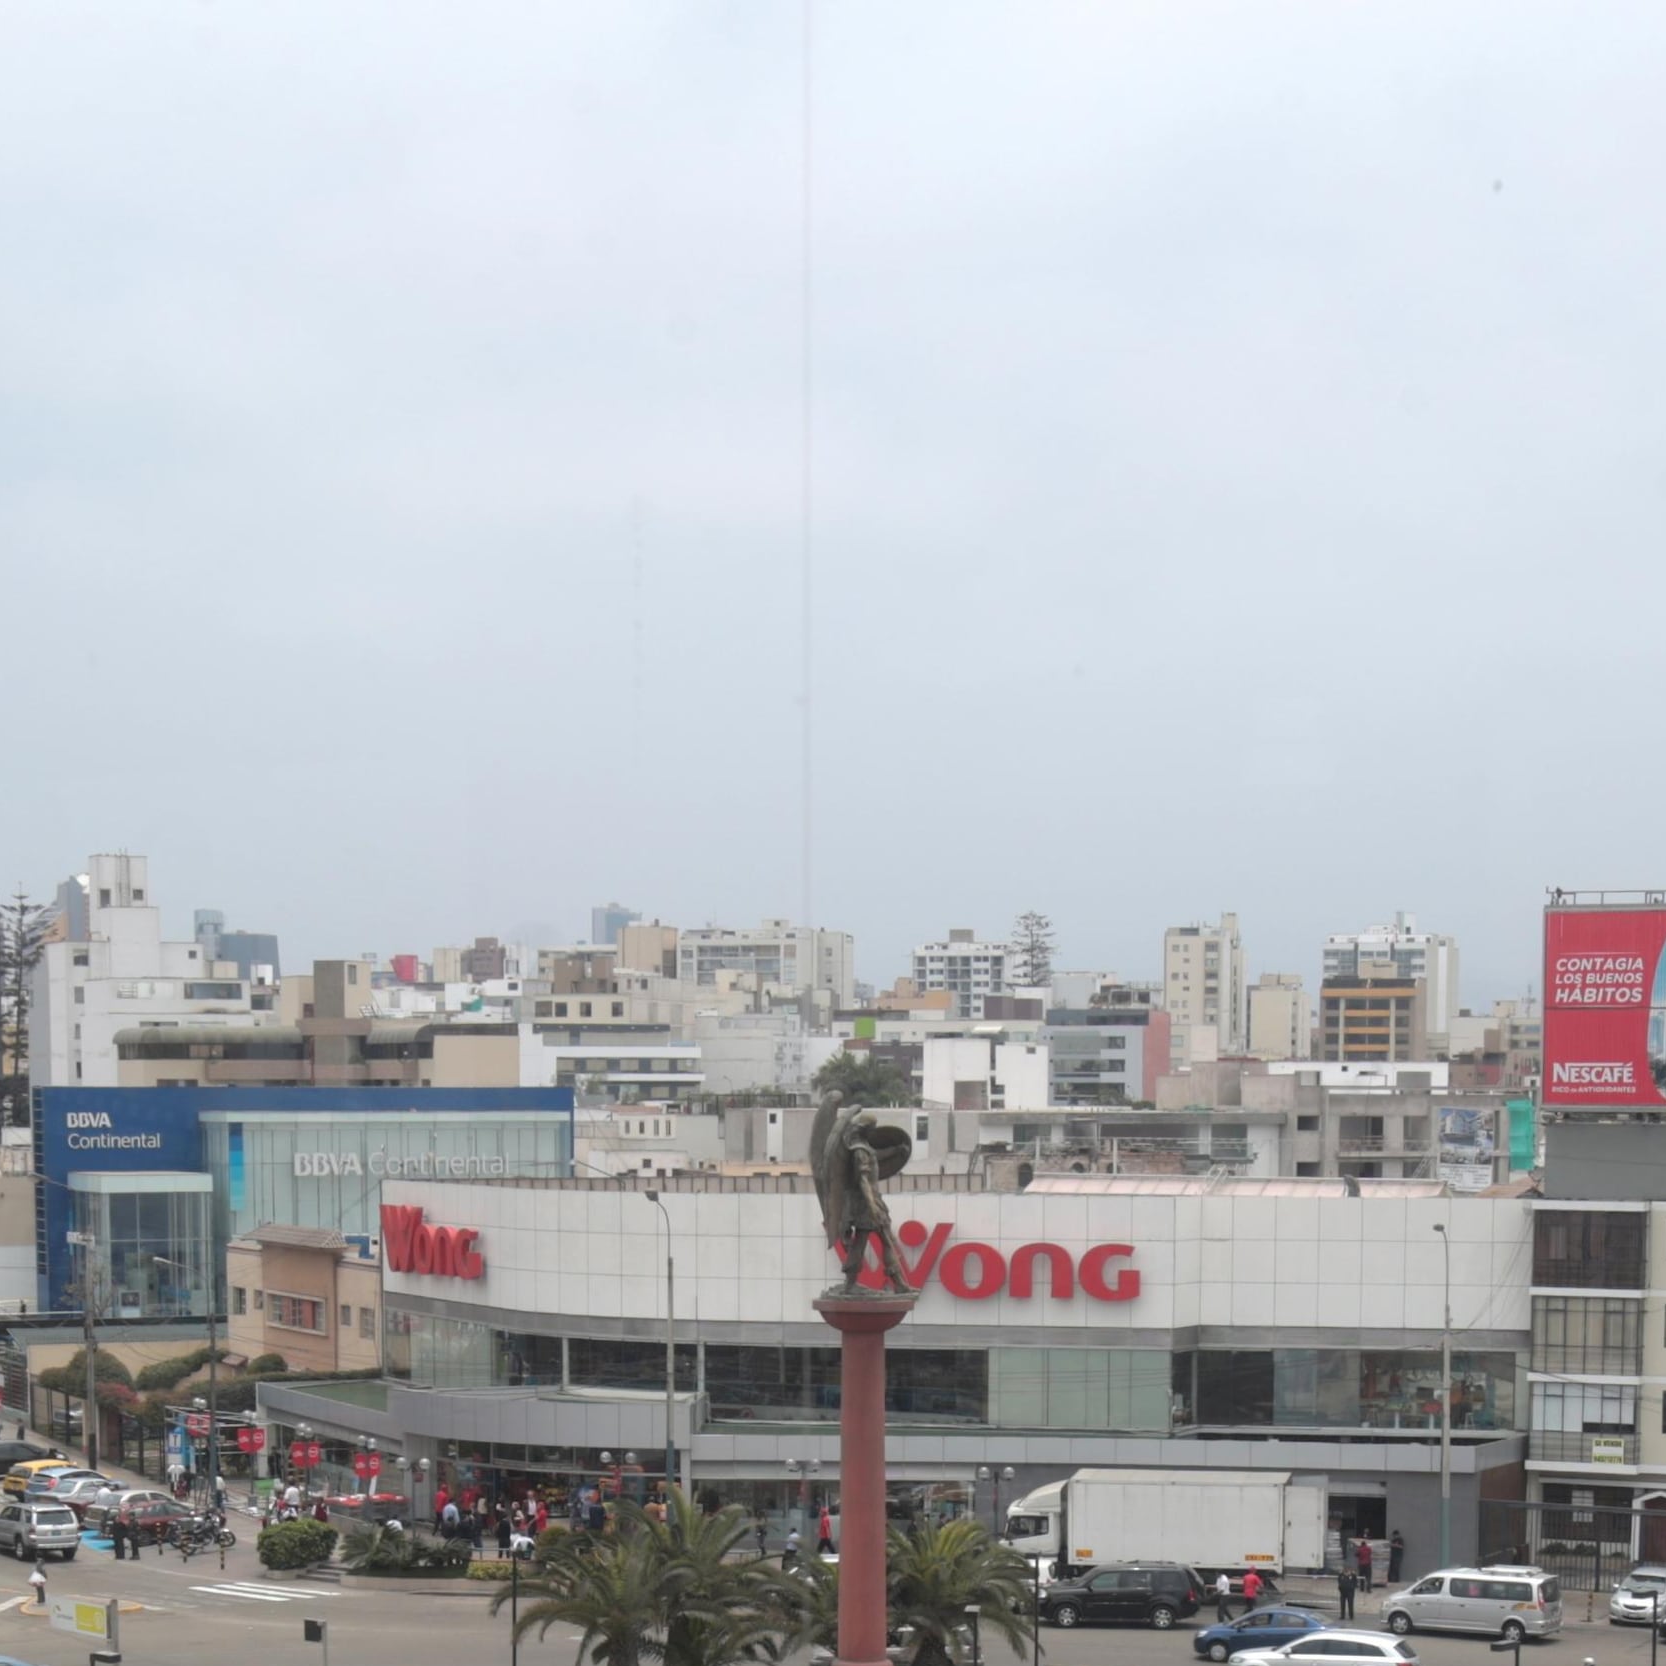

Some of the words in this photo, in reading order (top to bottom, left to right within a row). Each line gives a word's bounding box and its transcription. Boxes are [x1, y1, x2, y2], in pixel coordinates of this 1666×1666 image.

[1556, 957, 1644, 971] CONTAGIA
[1555, 973, 1583, 984] LOS
[1585, 972, 1643, 984] BUENOS
[1555, 984, 1643, 1003] HÁBITOS
[66, 1112, 112, 1129] BBVA
[68, 1132, 161, 1149] Continental
[294, 1152, 363, 1177] BBVA
[367, 1151, 510, 1176] Continental
